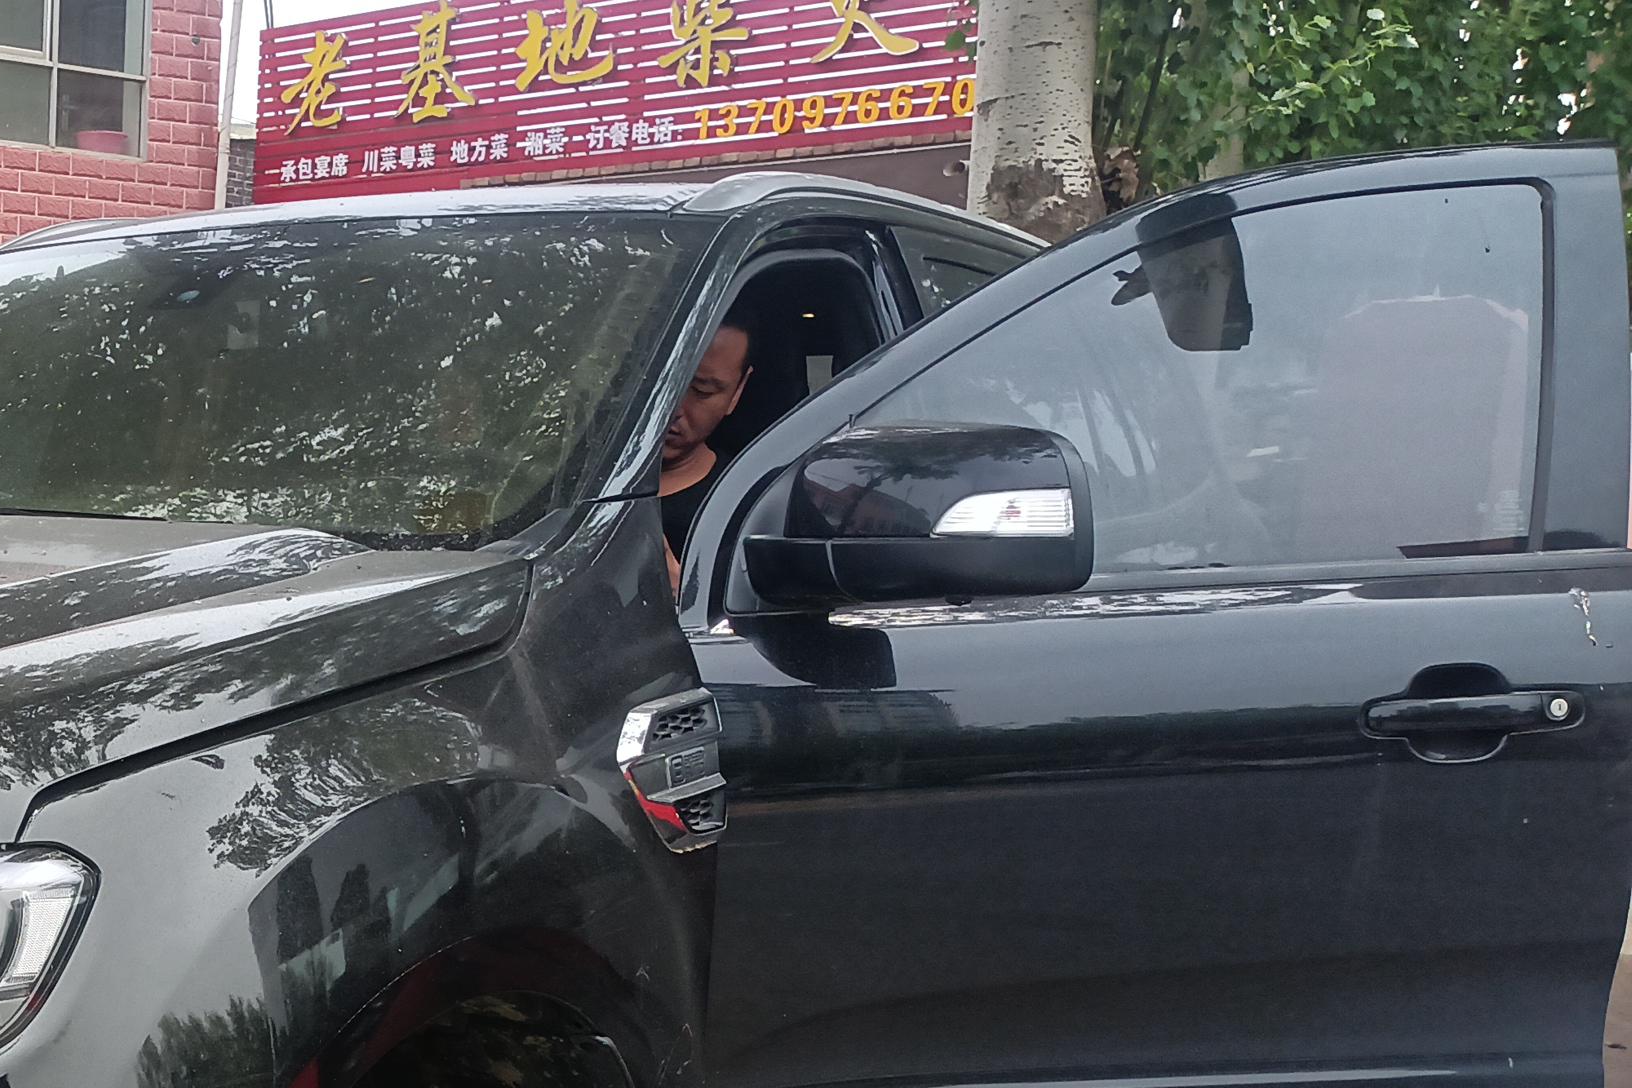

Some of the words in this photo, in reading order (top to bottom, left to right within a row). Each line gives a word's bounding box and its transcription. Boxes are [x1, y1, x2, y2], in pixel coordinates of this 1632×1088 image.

[280, 153, 349, 182] 承包宴席
[362, 143, 436, 174] 川菜粤菜
[450, 133, 509, 164] 地方菜
[694, 78, 975, 139] 1370976670
